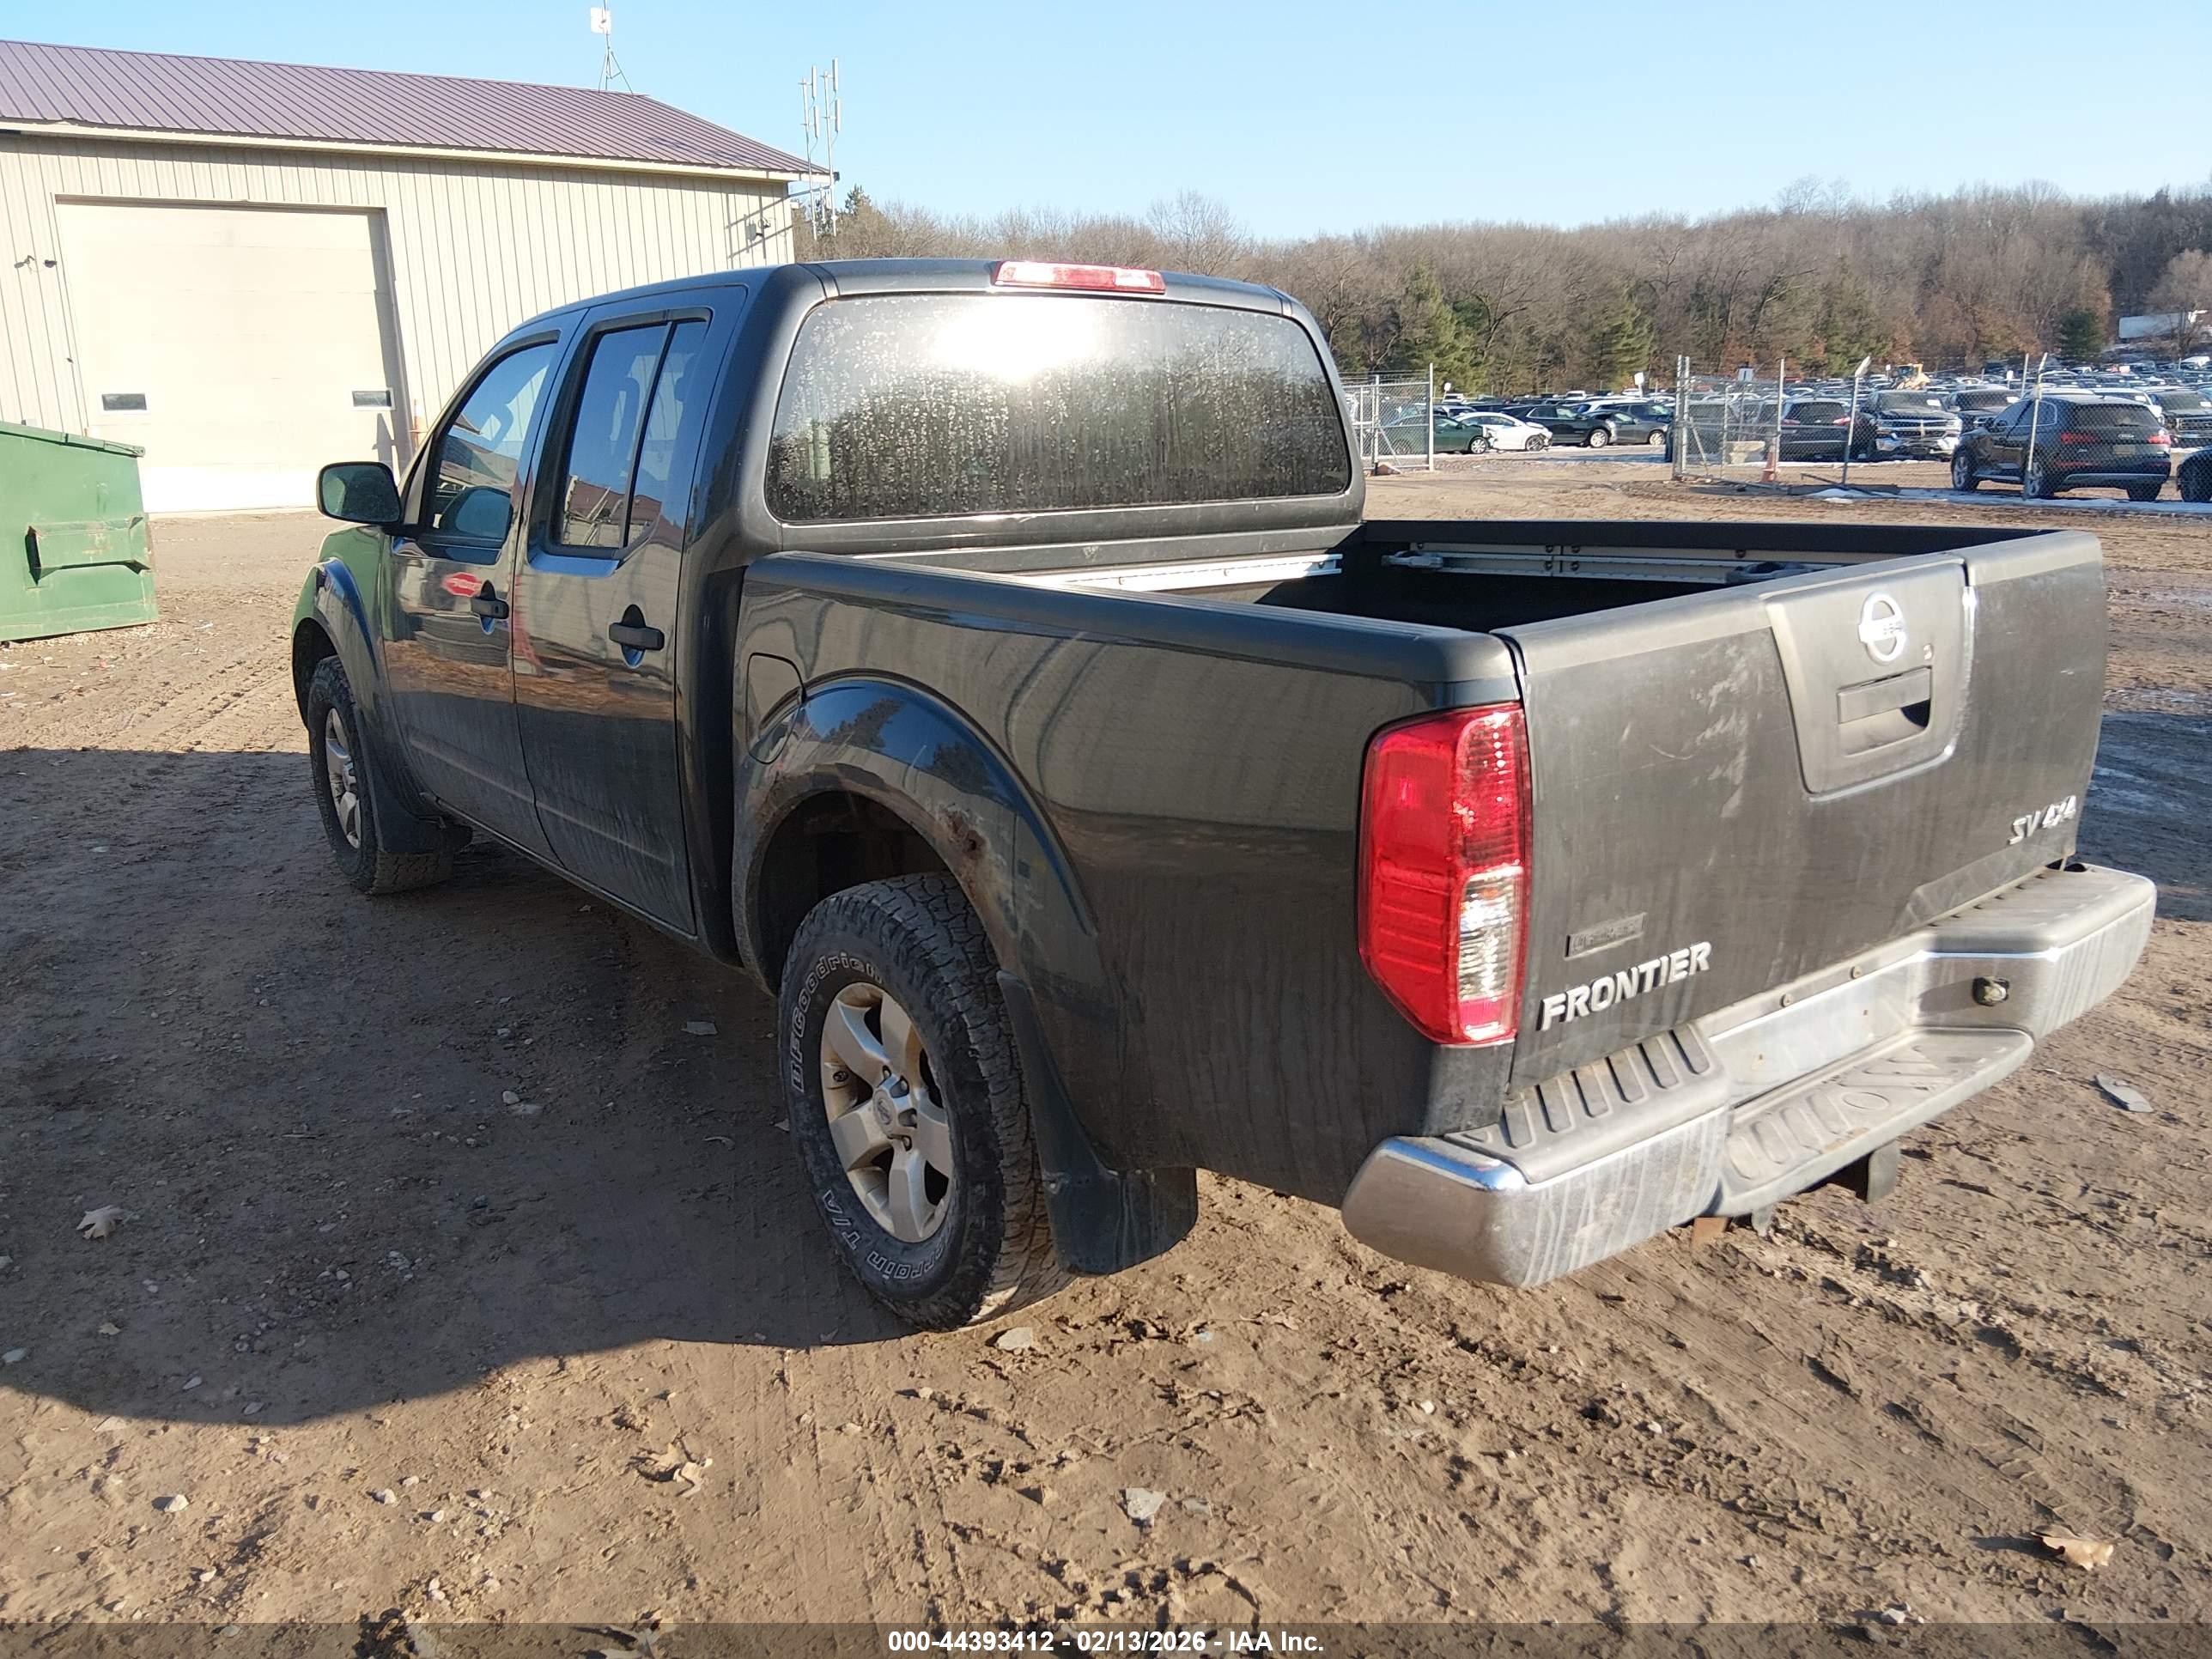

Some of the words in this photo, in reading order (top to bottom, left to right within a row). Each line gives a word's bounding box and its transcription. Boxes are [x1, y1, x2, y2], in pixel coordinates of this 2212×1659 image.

[2008, 810, 2041, 845] SV
[1537, 941, 1712, 1031] FRONTIER
[822, 1189, 860, 1250] T/A
